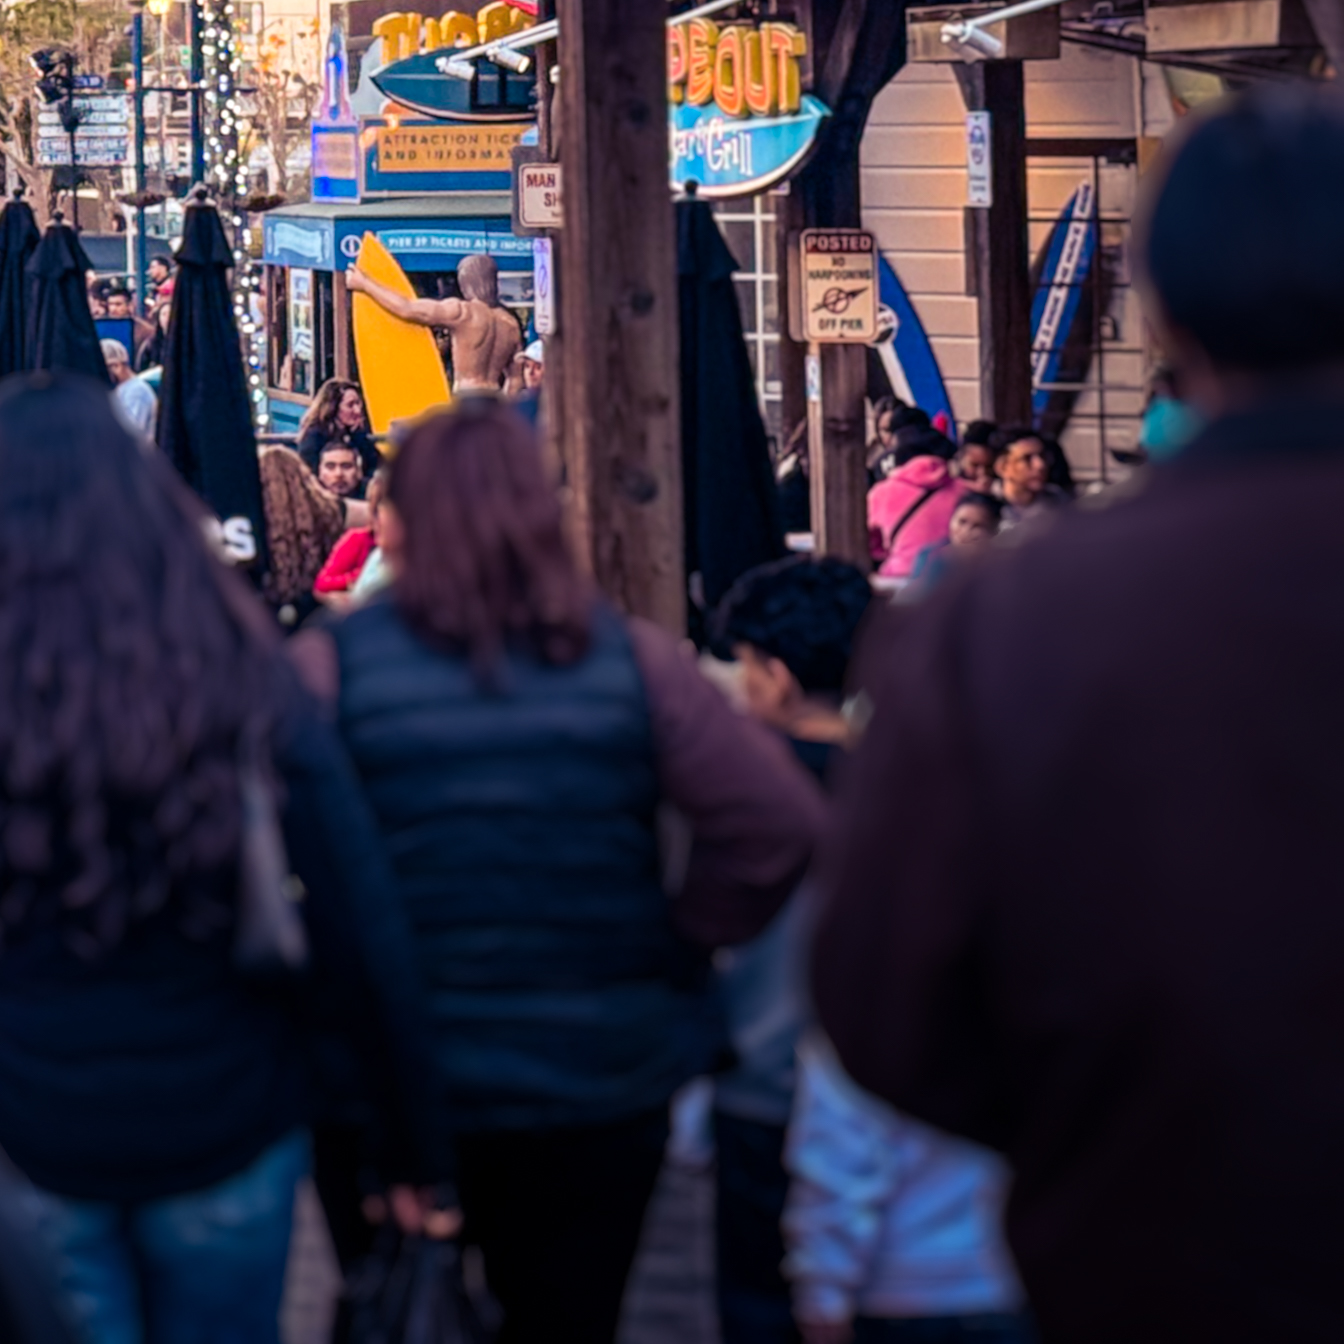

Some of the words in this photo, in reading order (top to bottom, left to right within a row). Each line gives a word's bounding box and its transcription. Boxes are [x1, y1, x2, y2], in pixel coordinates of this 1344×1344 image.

[383, 133, 479, 145] ATTRACTION
[706, 116, 753, 176] Grill
[384, 150, 418, 160] AND
[526, 172, 556, 188] MAN
[431, 236, 470, 248] TICKETS
[806, 236, 872, 251] POSTED
[808, 270, 872, 280] HARPOONING
[818, 319, 837, 330] OFF
[839, 318, 864, 330] PIER
